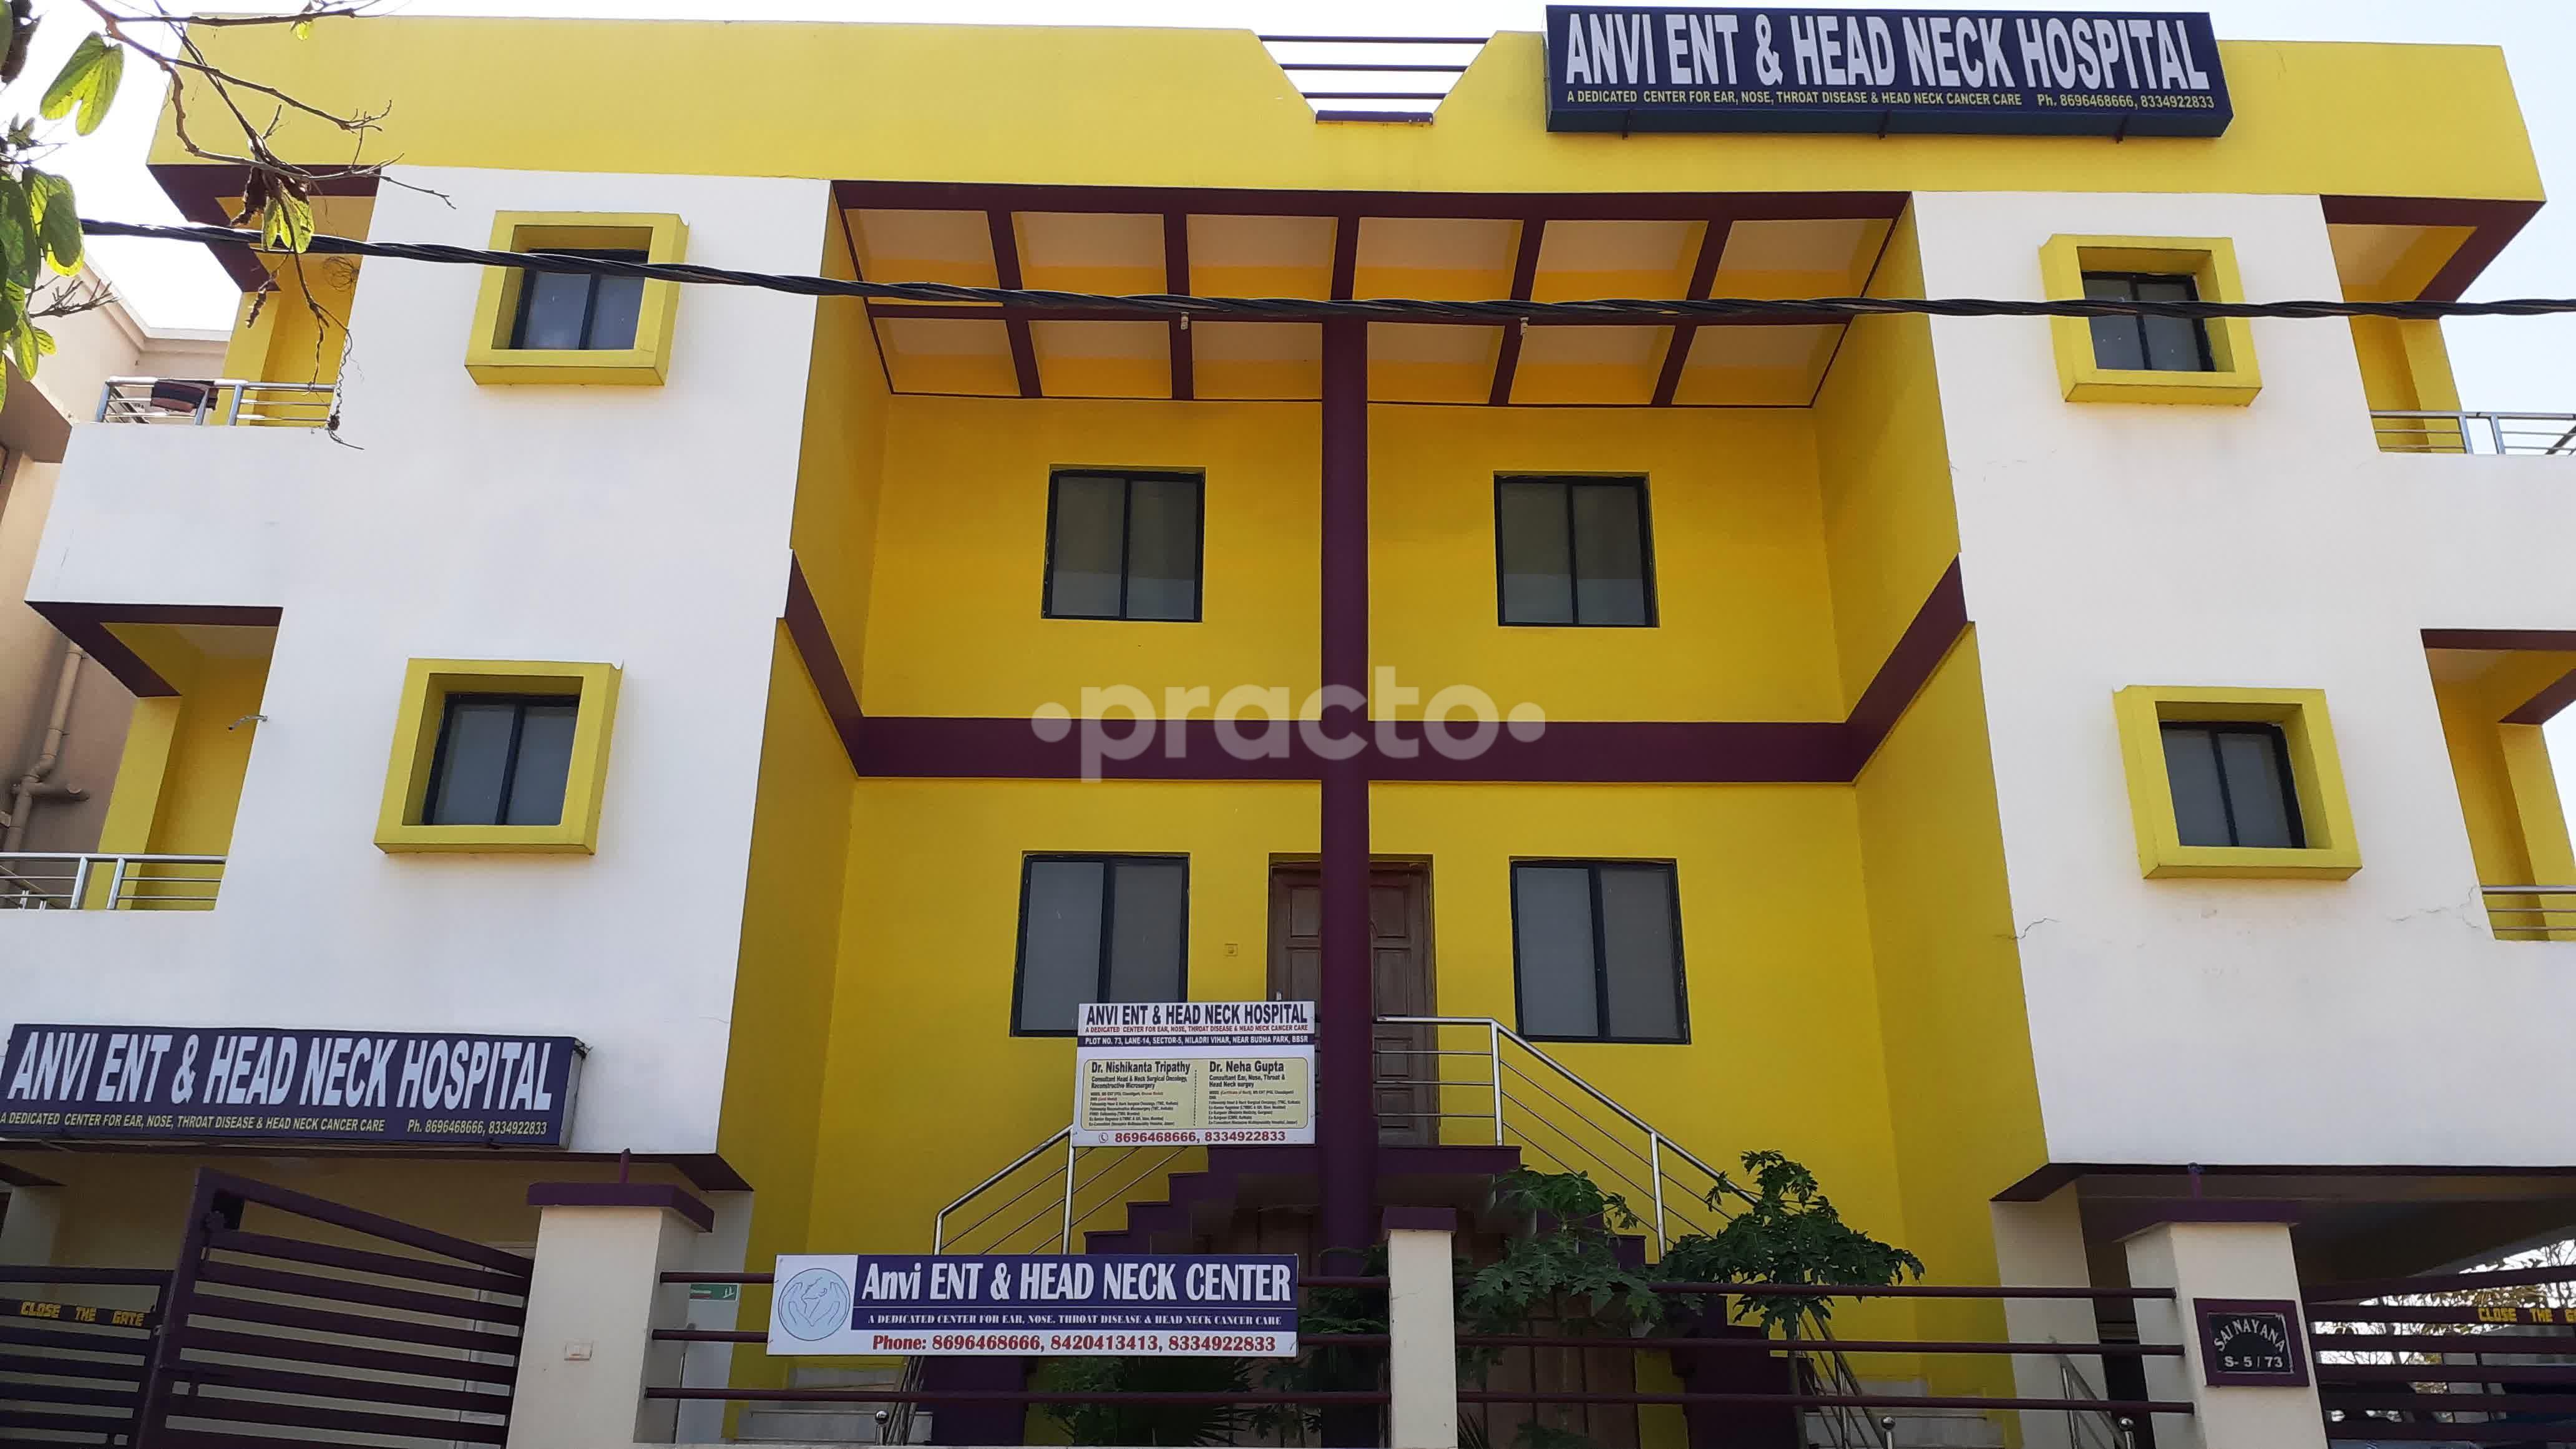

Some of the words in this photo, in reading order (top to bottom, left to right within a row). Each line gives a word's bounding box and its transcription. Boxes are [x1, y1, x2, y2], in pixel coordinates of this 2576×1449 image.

[1566, 14, 1656, 84] ANVI
[1665, 14, 1738, 85] ENT
[1755, 14, 1783, 86] &
[1790, 16, 1895, 86] HEAD
[1902, 17, 2015, 88] NECK
[2016, 17, 2210, 90] HOSPITAL
[1567, 91, 1576, 102] A
[1578, 91, 1637, 102] DEDICATED
[1644, 91, 1686, 103] CENTER
[1689, 92, 1710, 103] FOR
[1714, 92, 1739, 105] EAR,
[1741, 92, 1774, 105] NOSE,
[1776, 92, 1818, 104] THROAT
[1822, 92, 1867, 104] DISEASE
[1871, 92, 1877, 104] &
[1881, 92, 1911, 104] HEAD
[1913, 92, 1943, 105] NECK
[1946, 93, 1990, 105] CANCER
[1993, 94, 2022, 105] CARE
[2037, 94, 2057, 107] Ph.
[2060, 94, 2139, 110] 8696468666,
[2140, 95, 2214, 109] 8334922833
[1086, 1005, 1118, 1025] ANVI
[1123, 1005, 1148, 1025] ENT
[1153, 1005, 1161, 1025] &
[1166, 1005, 1200, 1025] HEAD
[1205, 1004, 1240, 1024] NECK
[1245, 1003, 1307, 1023] HOSPITAL
[1114, 1038, 1123, 1046] 73,
[1125, 1037, 1151, 1046] LANE-14,
[1153, 1037, 1183, 1045] SECTOR-5,
[1211, 1037, 1231, 1045] VIHAR,
[1273, 1036, 1290, 1044] PARK,
[7, 1032, 99, 1101] ANVI
[95, 1034, 173, 1103] ENT
[170, 1034, 200, 1104] &
[203, 1036, 298, 1105] HEAD
[299, 1037, 398, 1107] NECK
[396, 1039, 552, 1110] HOSPITAL
[1091, 1061, 1103, 1073] Dr.
[1106, 1061, 1152, 1073] Nishikanta
[1155, 1061, 1190, 1074] Tripathy
[1209, 1061, 1222, 1072] Dr.
[1226, 1061, 1251, 1071] Neha
[1254, 1061, 1284, 1074] Gupta
[0, 1112, 8, 1124] A
[9, 1112, 60, 1125] DEDICATED
[64, 1113, 100, 1125] CENTER
[104, 1114, 123, 1126] FOR
[124, 1115, 144, 1129] EAR,
[146, 1115, 173, 1129] NOSE,
[177, 1115, 214, 1128] THROAT
[215, 1116, 254, 1128] DISEASE
[256, 1117, 263, 1128] &
[266, 1117, 291, 1129] HEAD
[293, 1118, 319, 1130] NECK
[321, 1118, 359, 1131] CANCER
[361, 1119, 385, 1132] CARE
[407, 1119, 422, 1133] Ph.
[425, 1120, 485, 1136] 8696468666,
[488, 1121, 547, 1135] 8334922833
[1115, 1131, 1200, 1143] 8696468666,
[1205, 1131, 1286, 1141] 8334922833
[862, 1262, 921, 1300] Anvi
[930, 1263, 983, 1300] ENT
[990, 1263, 1011, 1301] &
[1020, 1263, 1095, 1300] HEAD
[1103, 1263, 1178, 1301] NECK
[1186, 1264, 1291, 1302] CENTER
[20, 1301, 61, 1319] CLOSE
[74, 1307, 97, 1322] THE
[111, 1310, 145, 1327] GATE
[868, 1315, 874, 1324] A
[877, 1315, 935, 1324] DEDICATED
[937, 1315, 976, 1324] CENTER
[979, 1315, 998, 1324] FOR
[1060, 1315, 1098, 1324] THROAT
[1101, 1315, 1142, 1324] DISEASE
[1144, 1315, 1152, 1324] &
[1155, 1315, 1182, 1324] HEAD
[1185, 1315, 1211, 1325] NECK
[1214, 1316, 1252, 1325] CANCER
[1255, 1317, 1282, 1325] CARE
[2477, 1307, 2517, 1322] CLOSE
[2529, 1307, 2553, 1322] THE
[873, 1335, 926, 1350] Phone:
[932, 1335, 1044, 1353] 8696468666,
[1050, 1335, 1163, 1353] 8420413413,
[1169, 1336, 1276, 1351] 8334922833
